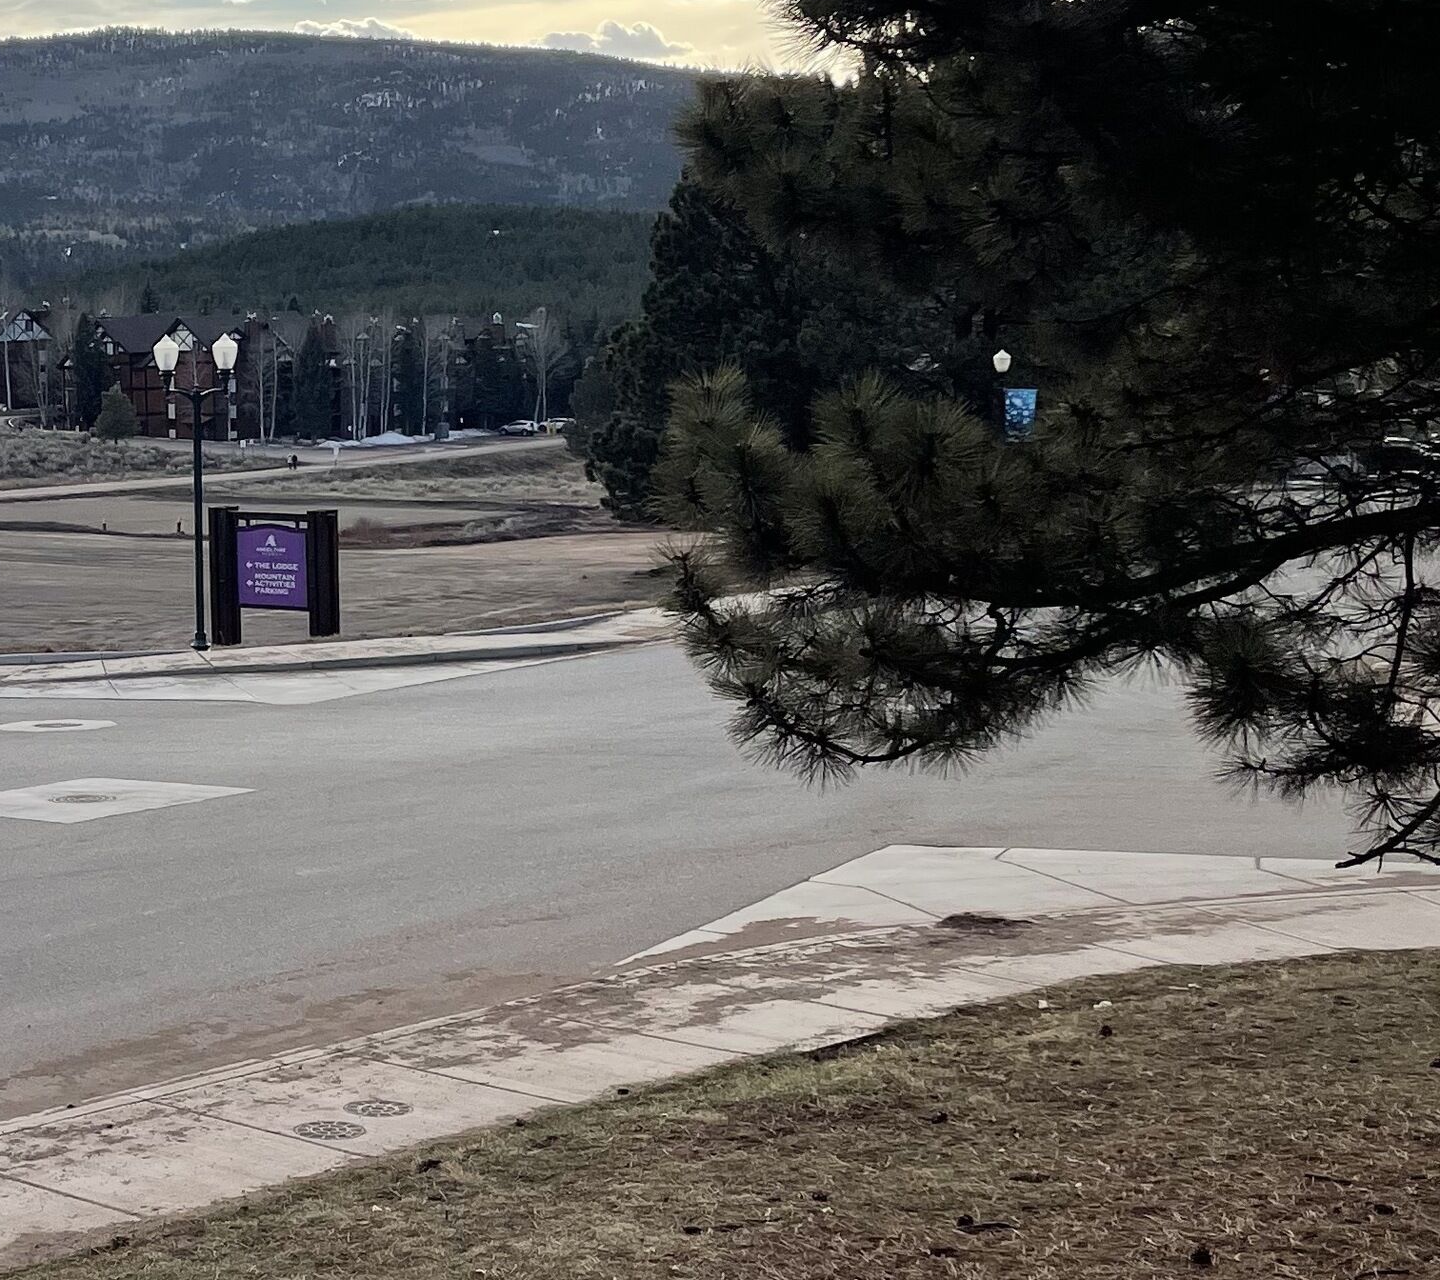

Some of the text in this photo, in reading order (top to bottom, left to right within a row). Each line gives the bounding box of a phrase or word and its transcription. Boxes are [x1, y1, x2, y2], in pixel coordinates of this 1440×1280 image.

[272, 562, 299, 570] LODGE
[254, 573, 296, 581] MOUNTAIN
[254, 580, 295, 588] ACTIVITIES
[254, 587, 288, 595] PARKING
